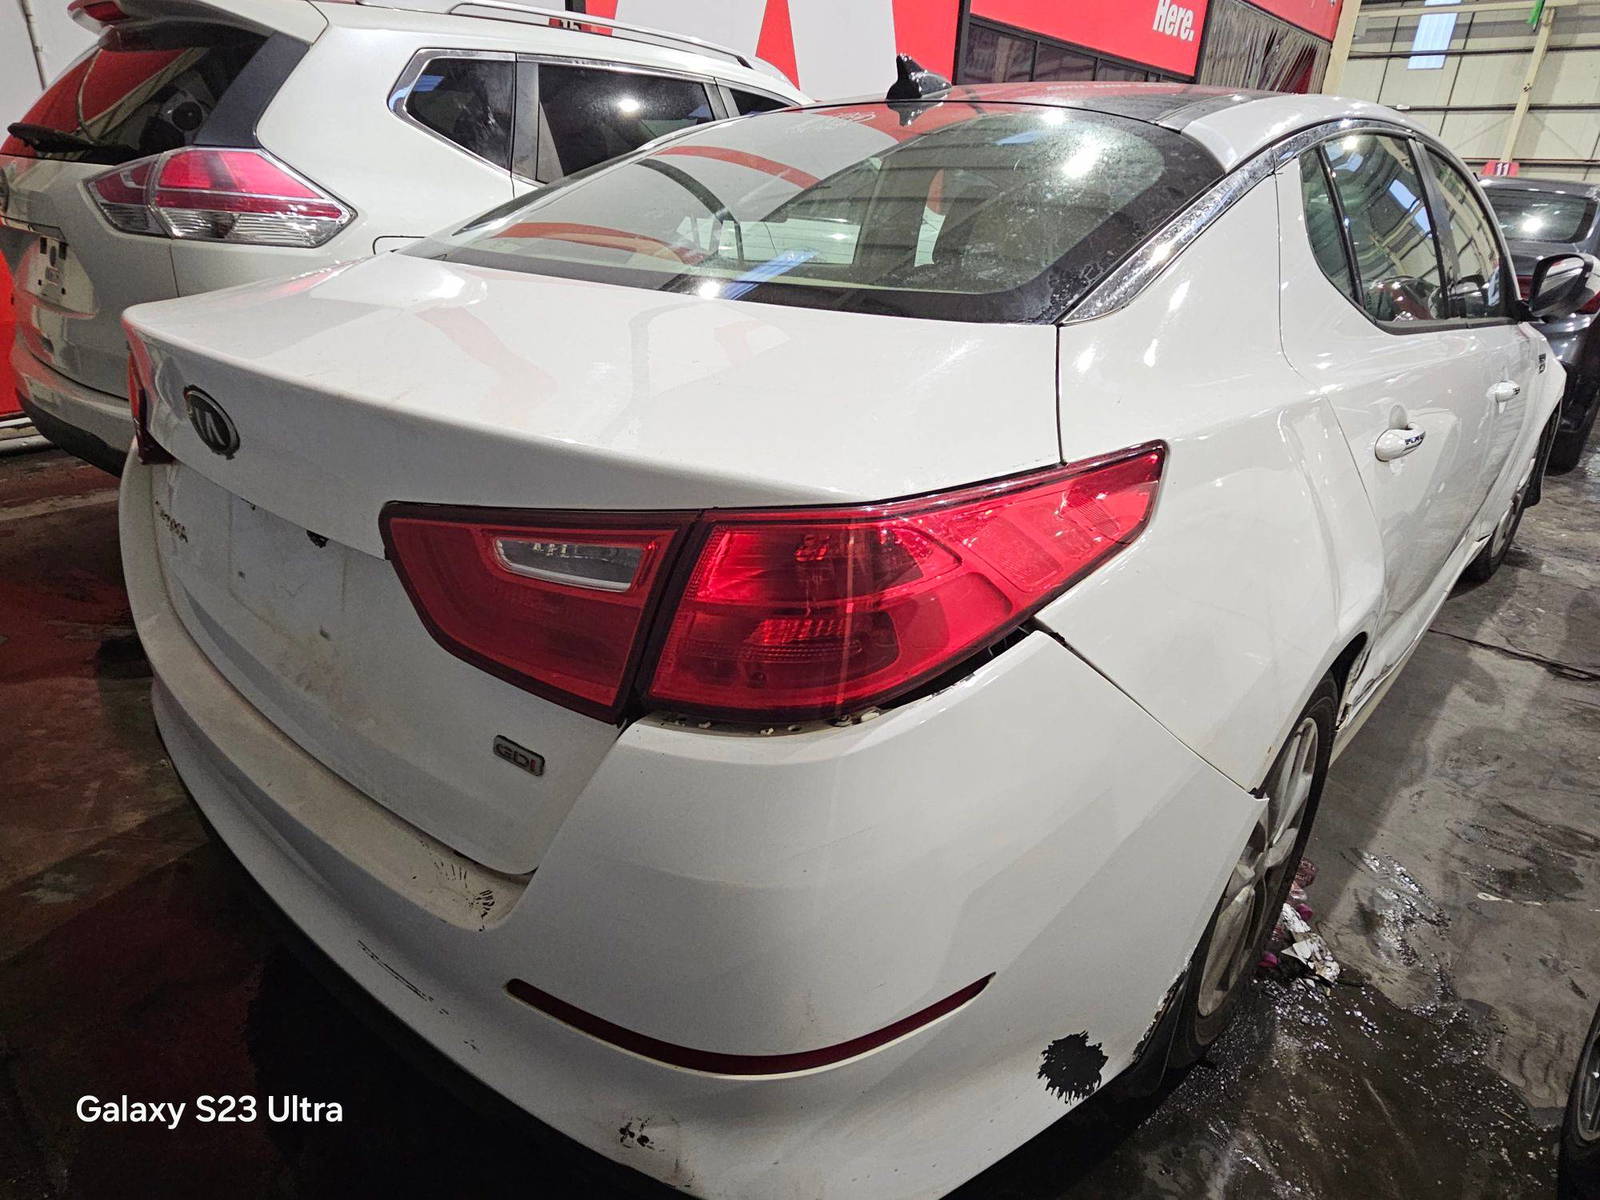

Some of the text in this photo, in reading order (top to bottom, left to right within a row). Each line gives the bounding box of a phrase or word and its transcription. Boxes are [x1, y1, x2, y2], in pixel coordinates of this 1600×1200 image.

[1152, 0, 1195, 42] Here.
[1496, 162, 1510, 177] 11
[495, 743, 537, 770] GDI
